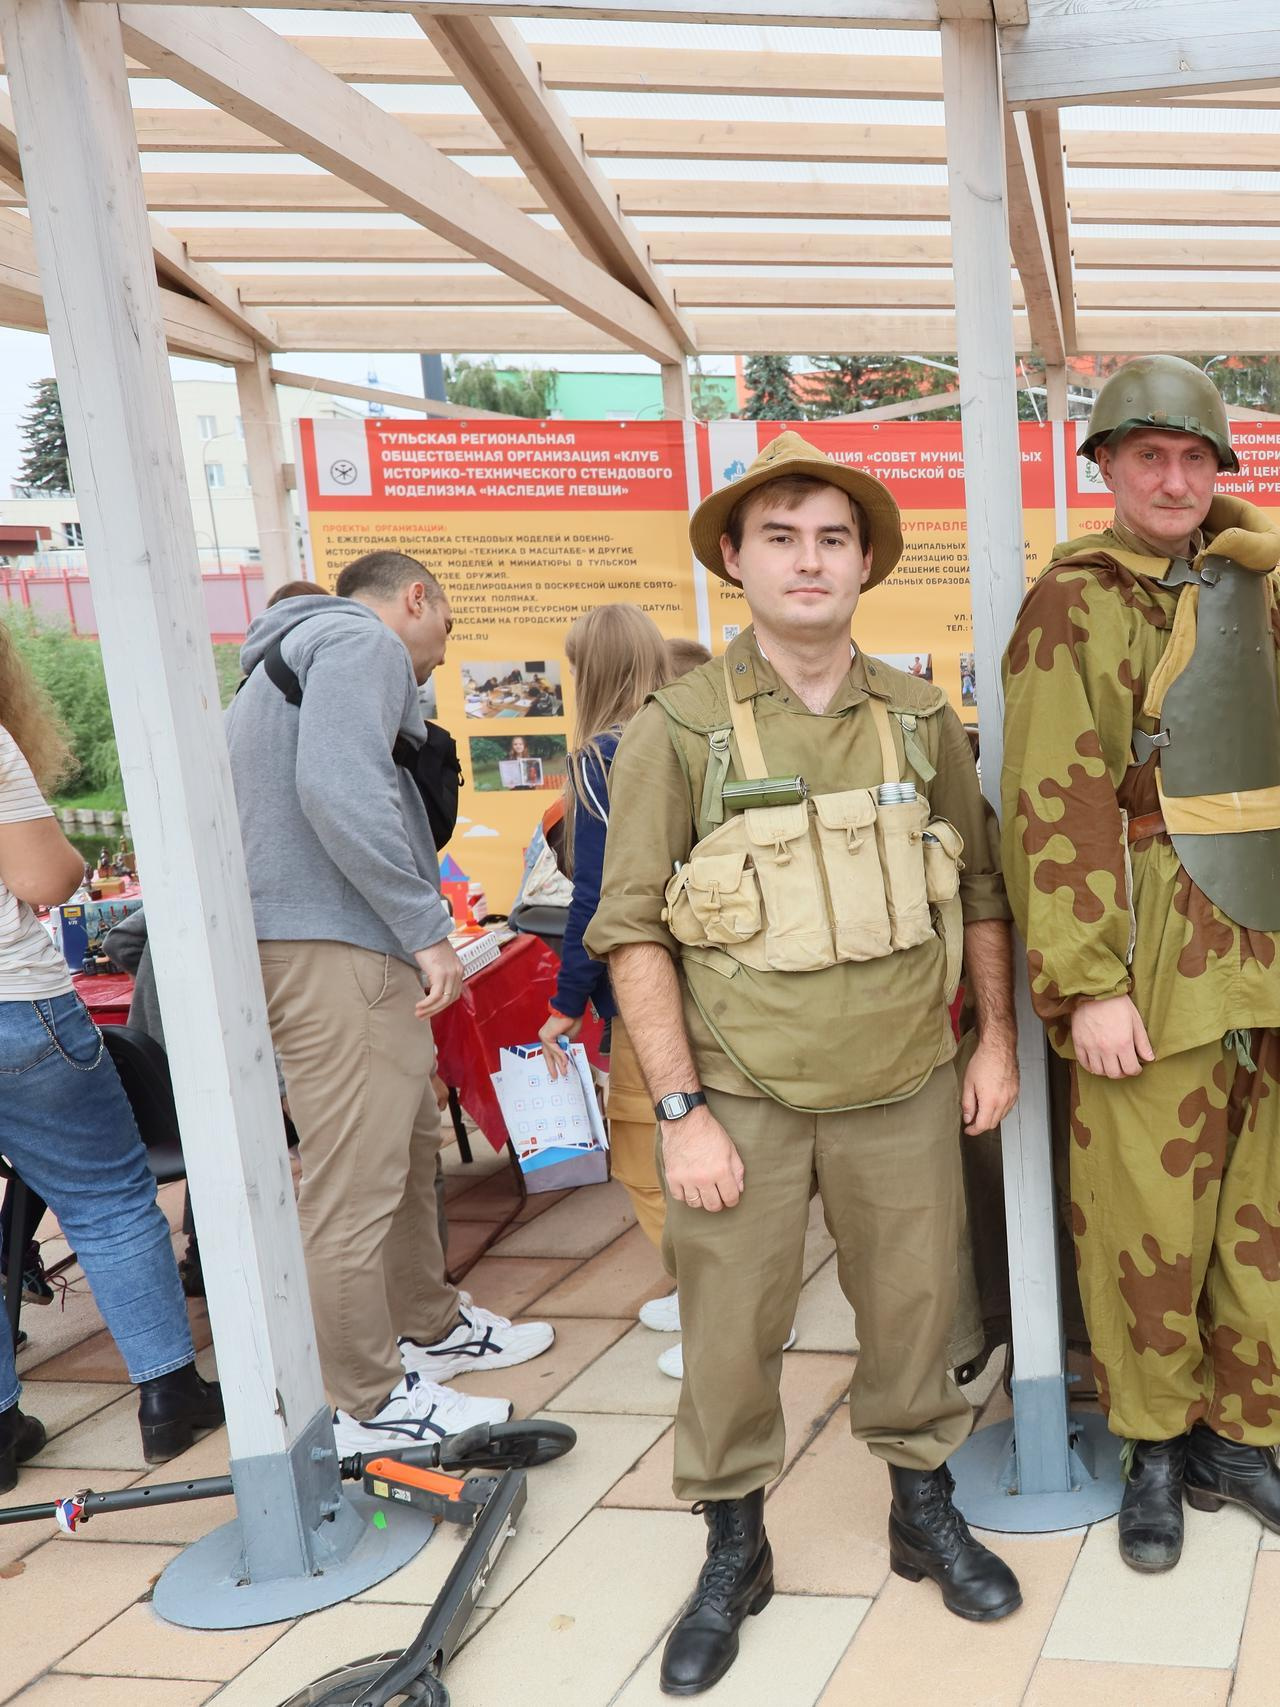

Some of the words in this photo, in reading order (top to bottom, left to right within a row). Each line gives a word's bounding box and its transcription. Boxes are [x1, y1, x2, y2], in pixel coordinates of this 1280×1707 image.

[379, 433, 457, 444] ТУЛЬСКАЯ
[461, 433, 575, 445] РЕГИОНАЛЬНАЯ
[381, 450, 503, 463] ОБЩЕСТВЕННАЯ
[507, 451, 610, 463] ОРГАНИЗАЦИЯ
[614, 451, 659, 462] «КЛУБ
[867, 452, 916, 463] «СОВЕТ
[383, 468, 577, 479] ИСТОРИКО-ТЕХНИЧЕСКОГО
[580, 468, 672, 480] СТЕНДОВОГО
[875, 466, 944, 479] ТУЛЬСКОЙ
[384, 485, 476, 497] МОДЕЛИЗМА
[480, 485, 565, 497] «НАСЛЕДИЕ
[568, 485, 629, 496] ЛЕВШИ»
[327, 536, 334, 544] 1.
[337, 536, 397, 544] ЕЖЕГОДНАЯ
[516, 535, 561, 543] МОДЕЛЕЙ
[573, 535, 614, 543] ВОЕННО-
[598, 547, 634, 555] ДРУГИЕ
[904, 543, 966, 551] ИЦИПАЛЬНЫХ
[901, 554, 954, 563] ГАНИЗАЦИЮ
[448, 560, 493, 568] МОДЕЛЕЙ
[510, 559, 572, 567] МИНИАТЮРЫ
[588, 559, 637, 567] ТУЛЬСКОМ
[898, 566, 940, 574] РЕШЕНИЕ
[545, 581, 605, 589] ВОСКРЕСНОЙ
[926, 576, 970, 585] ОБРАЗОВА
[450, 606, 519, 614] ЩЕСТВЕННОМ
[523, 605, 578, 613] РЕСУРСНОМ
[451, 617, 496, 625] ЛАССАМИ
[514, 616, 567, 624] ГОРОДСКИХ
